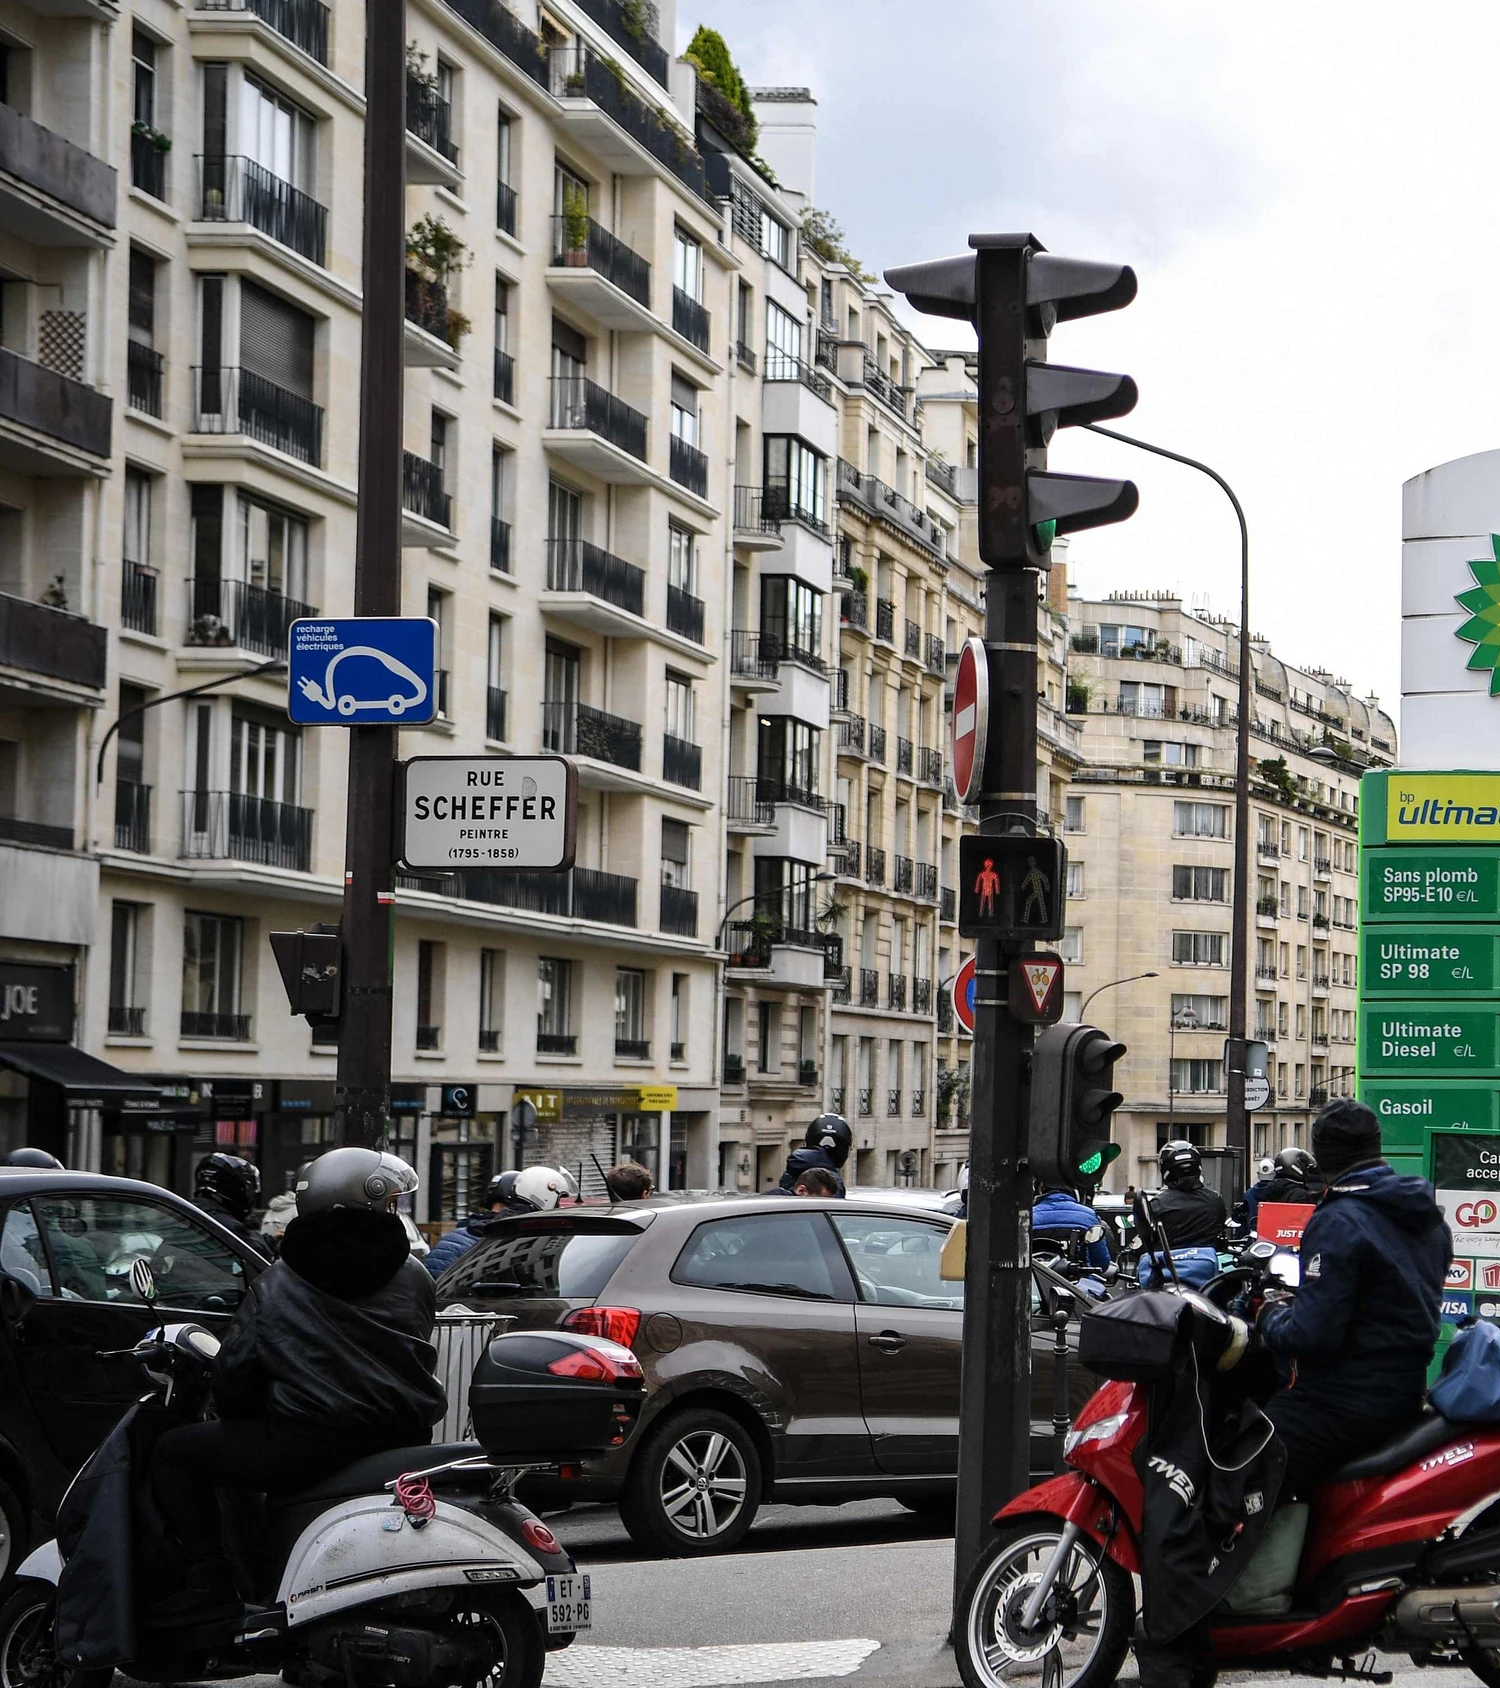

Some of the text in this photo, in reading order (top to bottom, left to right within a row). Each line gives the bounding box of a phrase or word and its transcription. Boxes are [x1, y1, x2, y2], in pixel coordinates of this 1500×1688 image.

[296, 625, 335, 634] recharge
[296, 633, 338, 642] véhicules
[296, 642, 345, 652] électriques
[467, 771, 505, 787] RUE
[1399, 790, 1415, 804] bp
[414, 795, 556, 821] SCHEFFER
[459, 829, 509, 839] PEINTRE
[1383, 867, 1479, 886] Sans plomb
[1383, 886, 1479, 903] SP95-E10 €/L
[1379, 944, 1460, 960] Ultimate
[1379, 963, 1474, 980] SP 98 €/L
[1, 984, 38, 1020] JOE
[1381, 1021, 1462, 1038] Ultimate
[1381, 1041, 1476, 1058] Diesel €/L
[1379, 1098, 1432, 1115] Gasoil
[1455, 1199, 1498, 1228] GO
[1275, 1229, 1296, 1239] JUST
[1447, 1269, 1466, 1279] KV
[1148, 1456, 1195, 1500] TWEE
